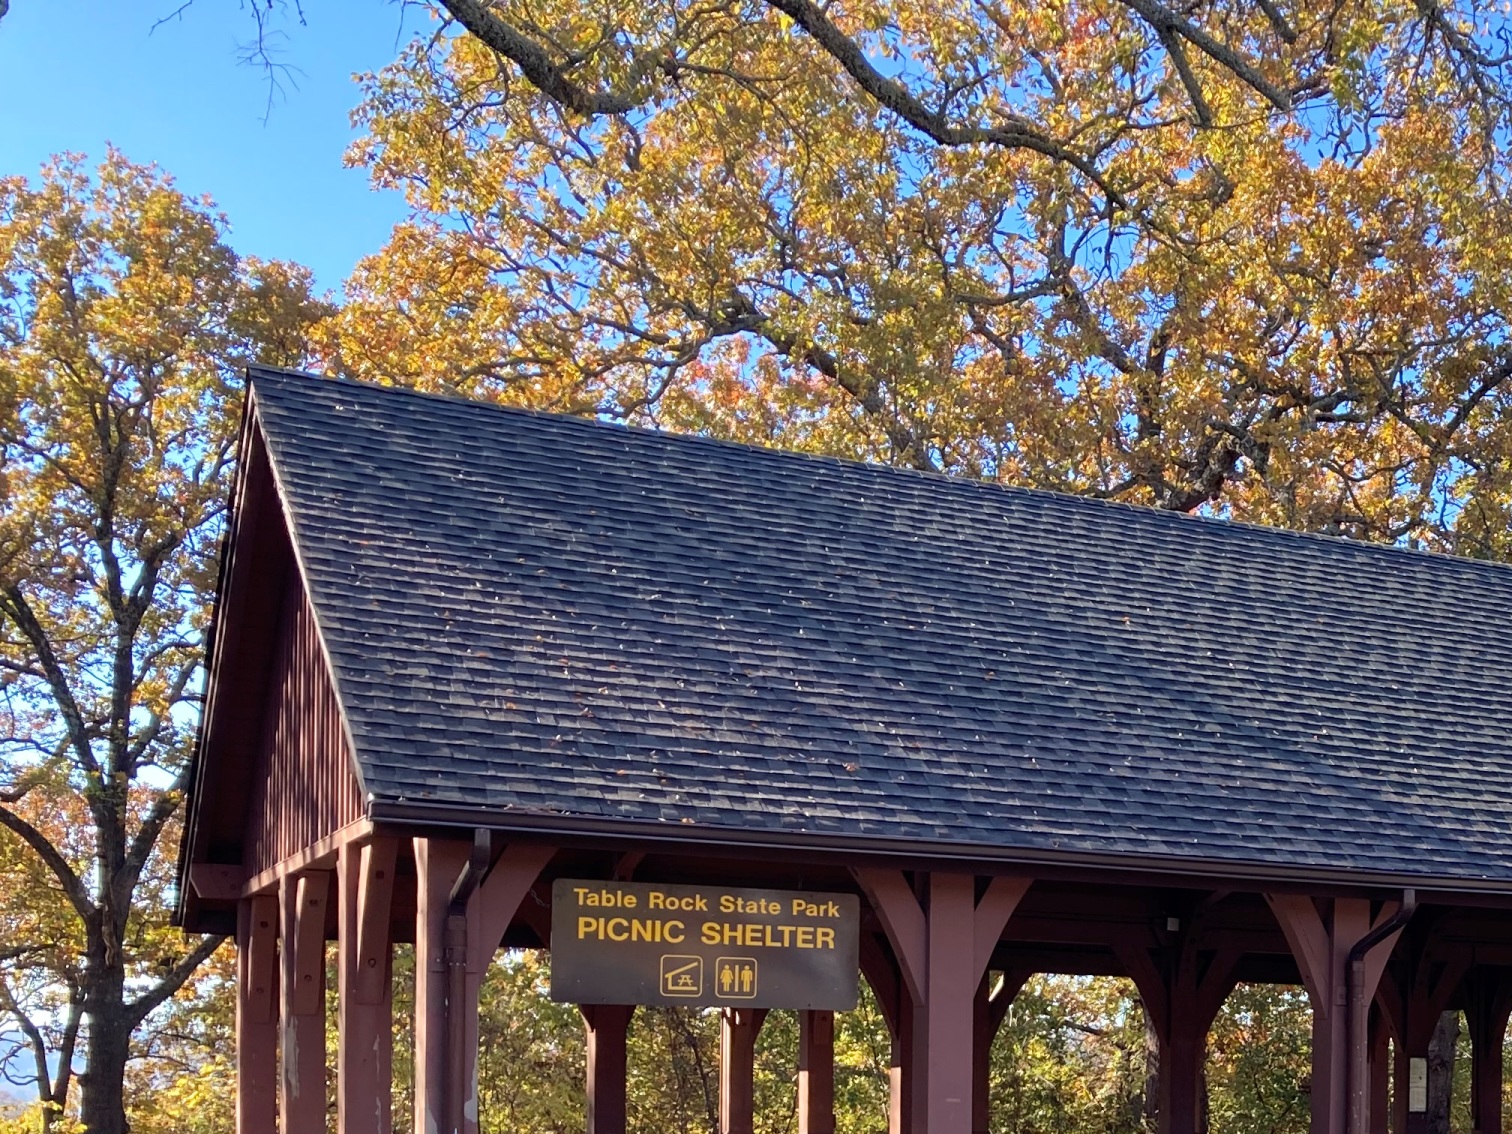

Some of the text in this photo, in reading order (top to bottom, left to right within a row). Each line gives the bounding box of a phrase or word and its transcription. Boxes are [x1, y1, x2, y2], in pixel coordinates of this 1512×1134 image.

[573, 887, 841, 919] Table Rock State Park
[577, 916, 835, 949] PICNIC SHELTER
